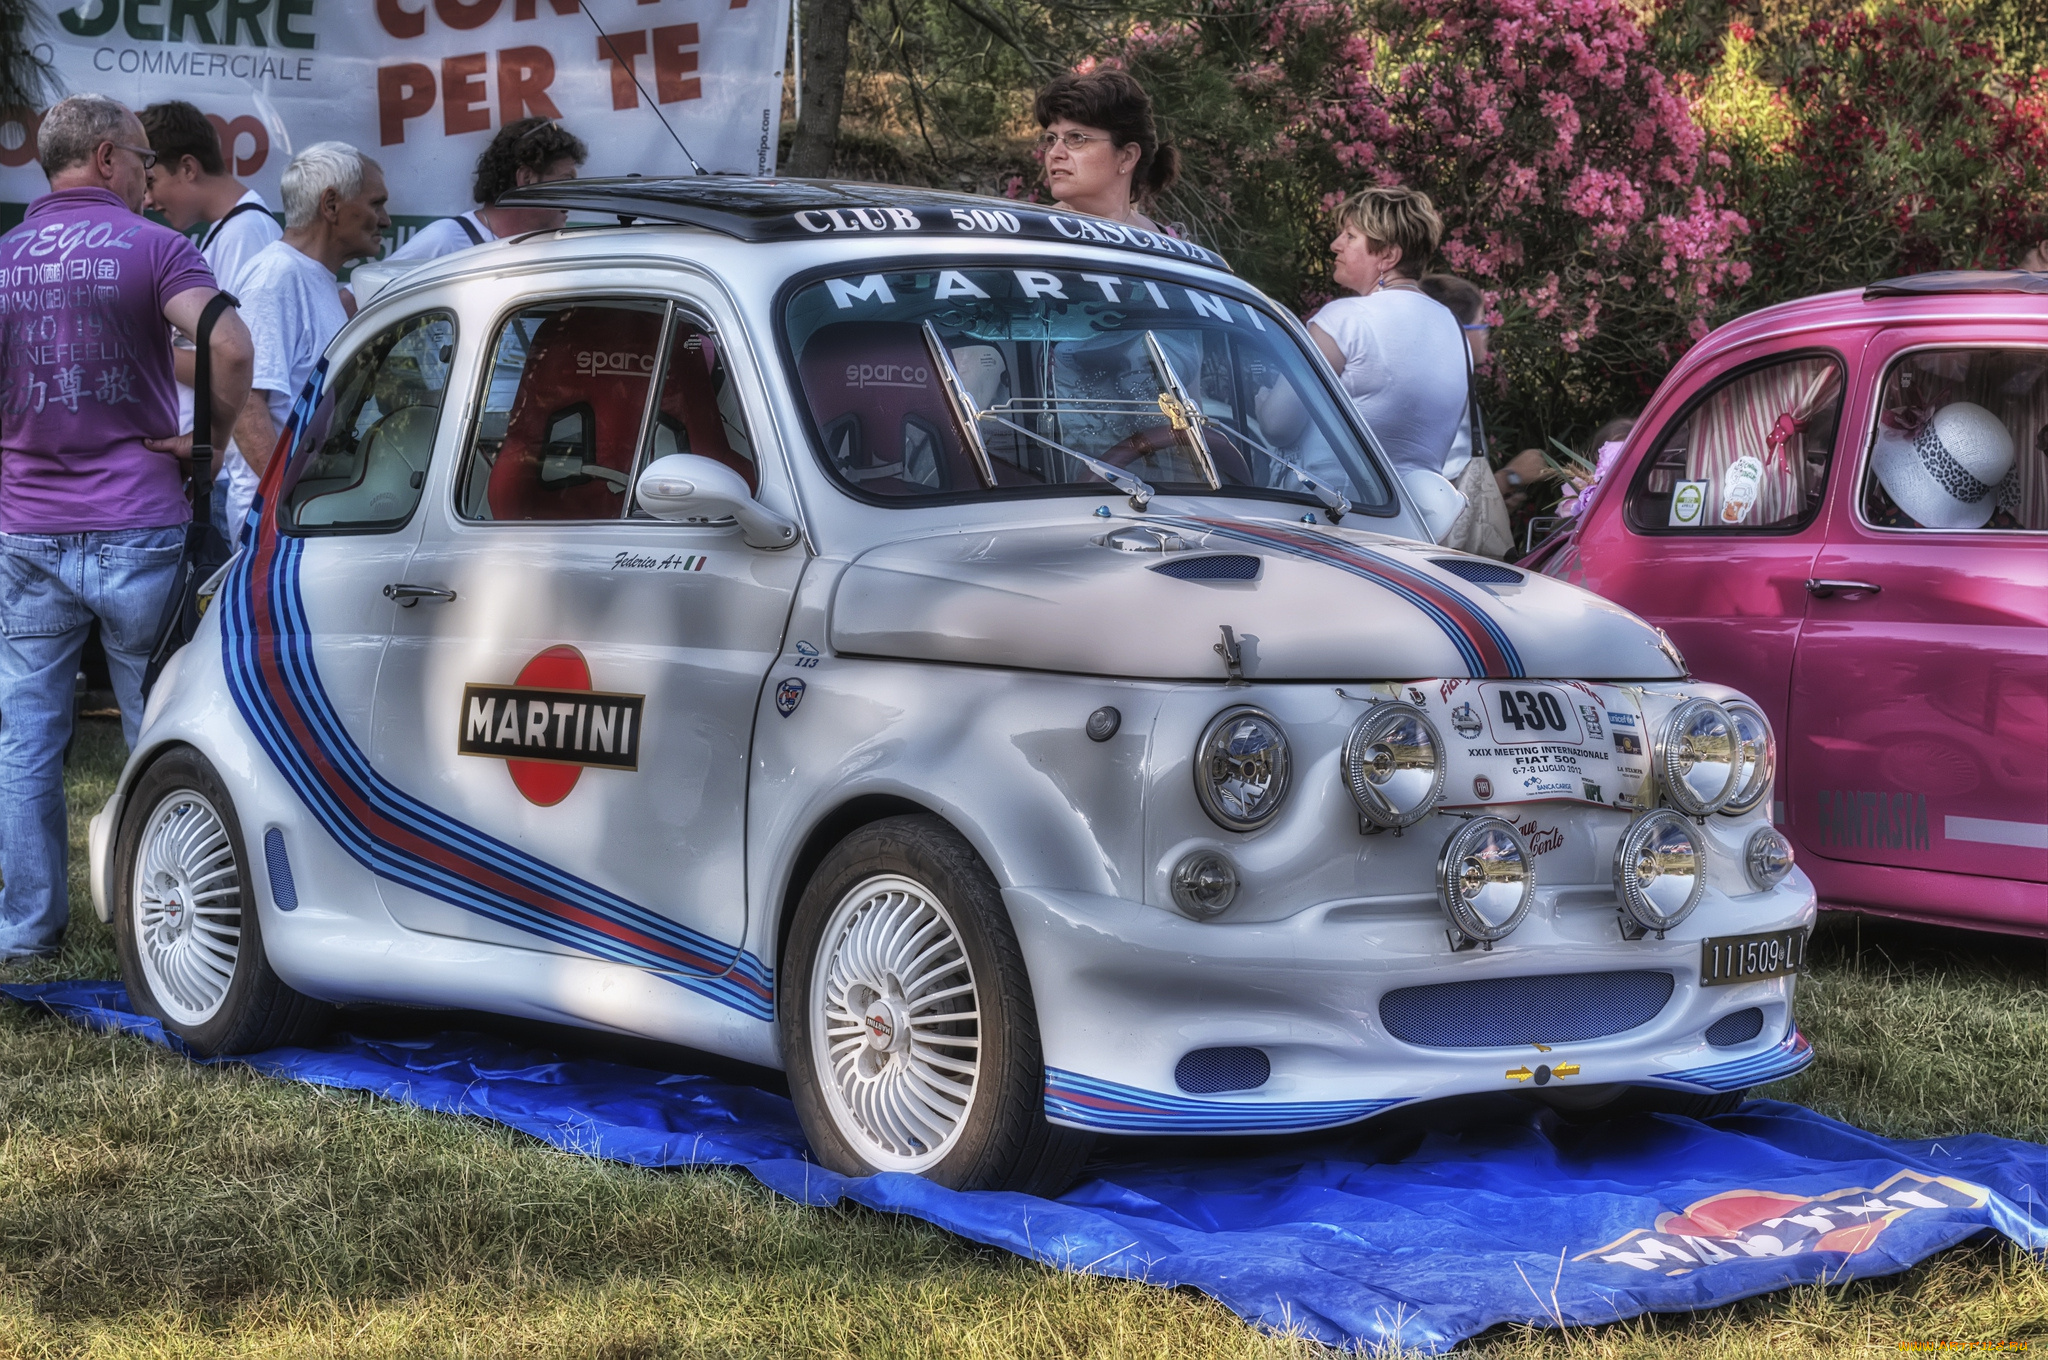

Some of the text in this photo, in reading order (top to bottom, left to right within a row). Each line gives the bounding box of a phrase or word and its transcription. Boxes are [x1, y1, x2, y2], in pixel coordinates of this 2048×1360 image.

[94, 47, 313, 81] COMMERCIALE
[377, 44, 564, 147] PER
[596, 22, 702, 112] TE
[757, 109, 770, 177] urotipo.com
[794, 208, 1214, 263] CLUB 500 CASCINA
[824, 270, 1267, 332] MARTINI
[576, 350, 670, 377] sparc
[846, 364, 928, 388] sparco
[611, 551, 657, 570] Federico
[794, 656, 820, 668] 113
[1499, 690, 1567, 731] 430
[1609, 713, 1627, 724] unicef
[466, 696, 633, 755] MARTINI
[1468, 746, 1609, 760] XXIX MEETING INTERNAZIONALE
[1515, 755, 1577, 765] FIAT 500
[1512, 764, 1582, 775] 6-7-8 LUGLIO 2012
[1625, 766, 1643, 774] STAMPA
[1477, 781, 1490, 794] FIAT
[1816, 790, 1931, 852] FANTASIA
[1529, 826, 1565, 858] Cento
[1712, 940, 1779, 979] 111509
